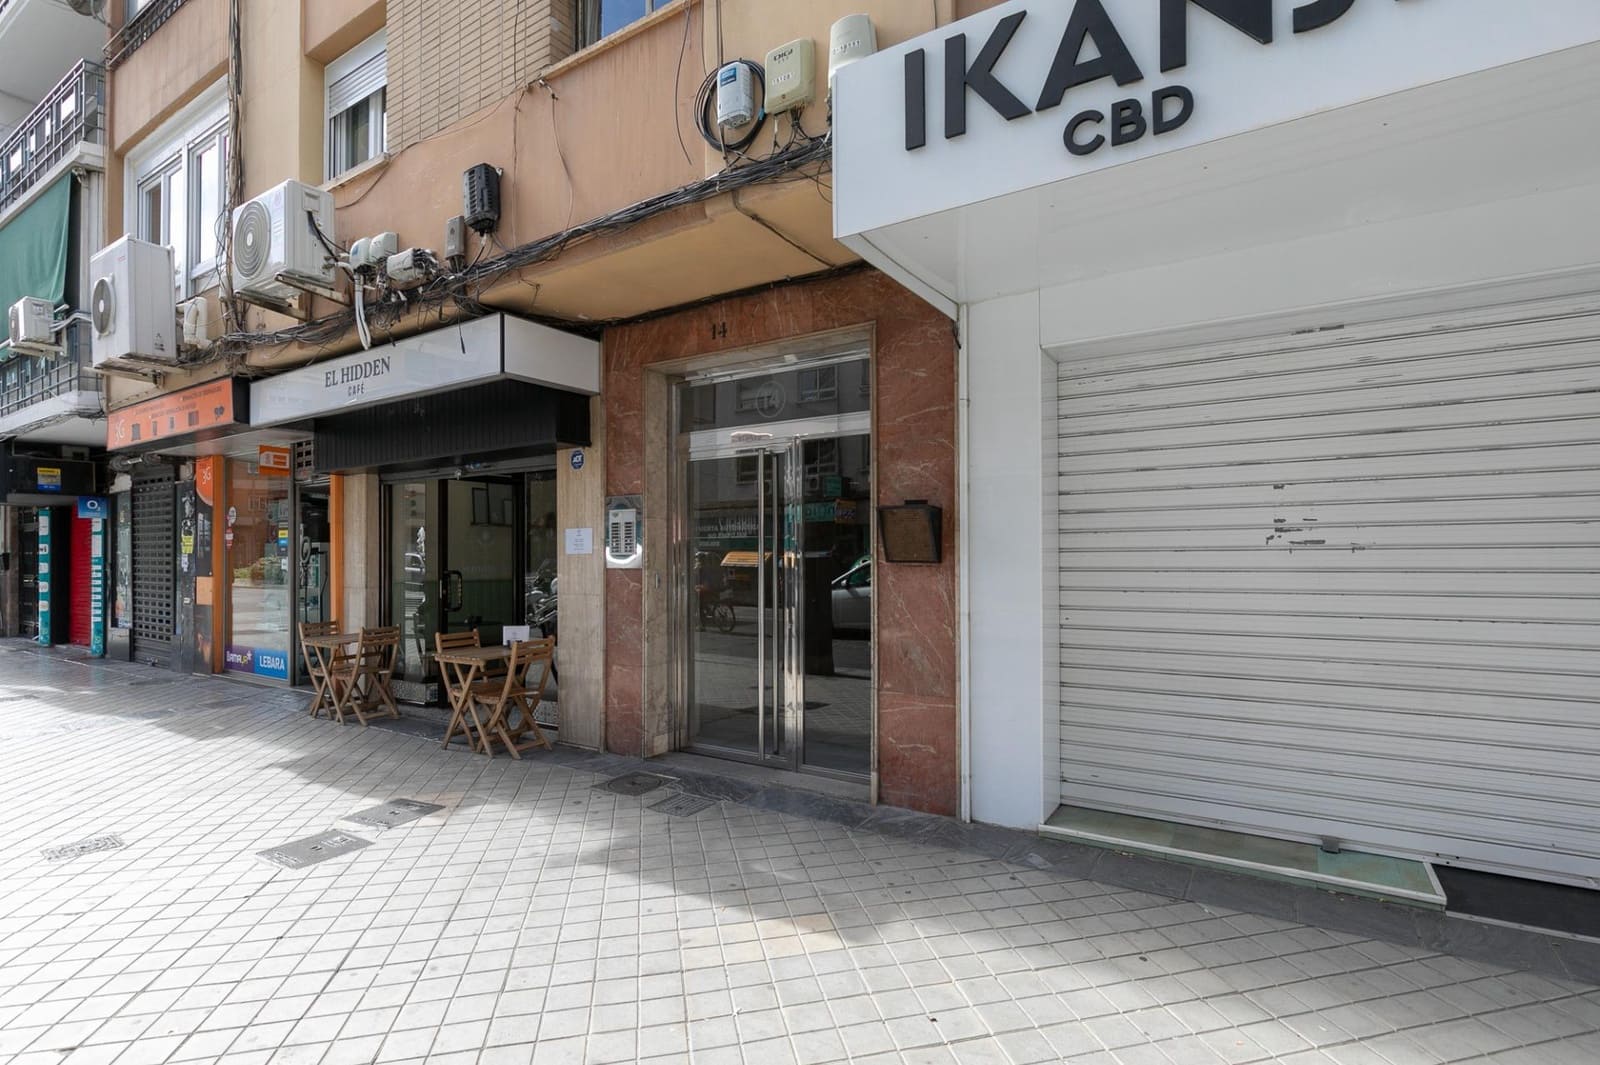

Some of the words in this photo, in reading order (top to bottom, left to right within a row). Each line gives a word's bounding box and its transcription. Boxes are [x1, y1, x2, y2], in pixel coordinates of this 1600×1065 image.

[1063, 85, 1194, 156] CBD
[711, 322, 728, 340] 14
[325, 370, 338, 388] EL
[341, 356, 391, 384] HIDDEN
[347, 381, 365, 397] CAFÉ
[259, 655, 285, 671] LEBARA
